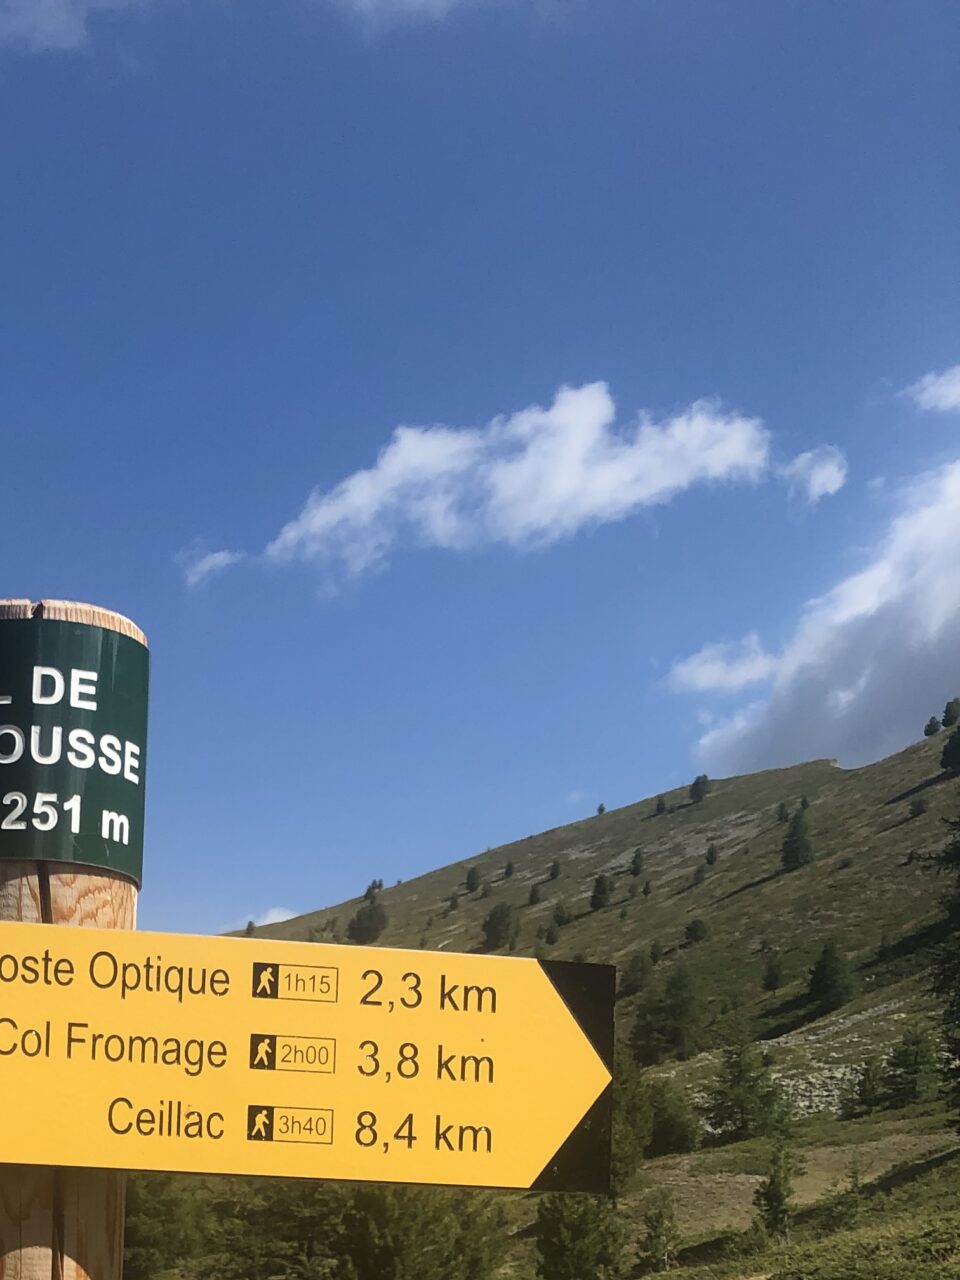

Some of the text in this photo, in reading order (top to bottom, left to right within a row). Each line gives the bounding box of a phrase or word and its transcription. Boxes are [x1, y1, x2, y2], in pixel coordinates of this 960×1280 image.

[31, 665, 98, 712] DE
[102, 809, 129, 845] m
[89, 951, 230, 1003] Optique
[284, 973, 331, 994] 1h15
[359, 969, 424, 1012] 2,3
[439, 974, 497, 1013] km
[66, 1022, 228, 1076] Fromage
[281, 1044, 329, 1065] 2h00
[356, 1040, 420, 1082] 3,8
[437, 1045, 495, 1083] km
[107, 1097, 493, 1153] Ceillac 3h40 8,4 km
